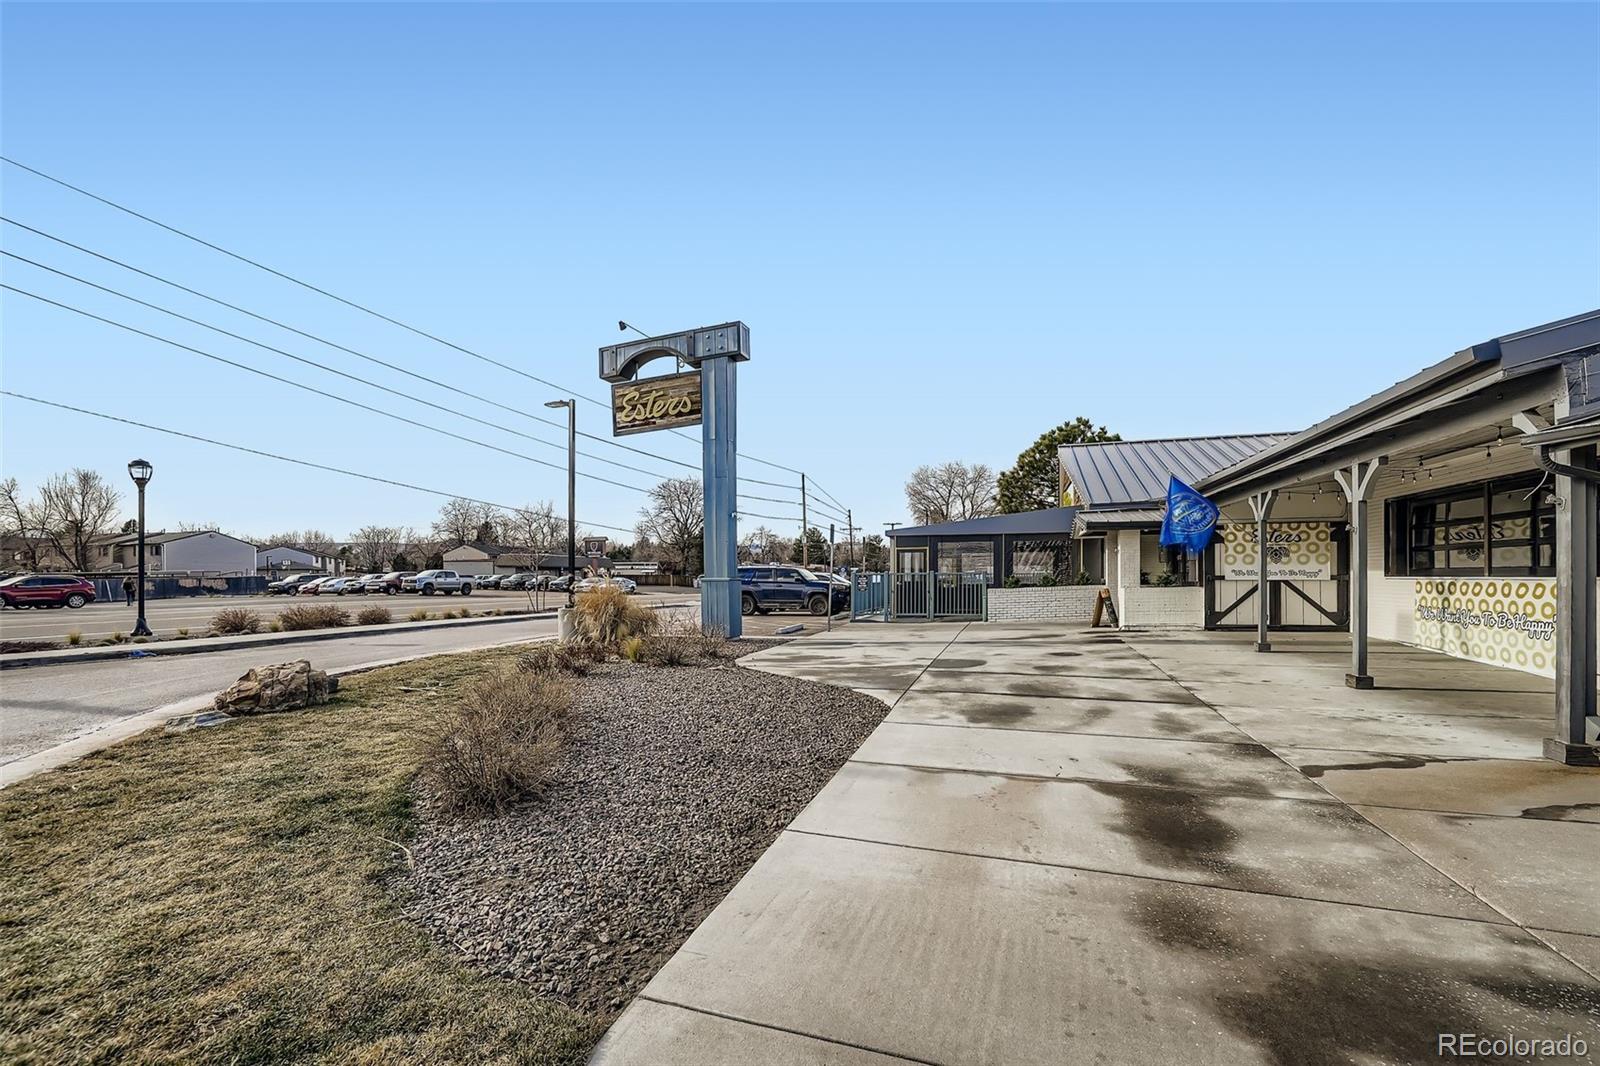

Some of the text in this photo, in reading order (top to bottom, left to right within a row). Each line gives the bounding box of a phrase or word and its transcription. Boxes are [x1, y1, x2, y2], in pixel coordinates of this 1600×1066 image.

[621, 390, 692, 422] Esters
[1250, 529, 1302, 544] Eters
[1460, 608, 1481, 630] You
[1480, 610, 1497, 628] To
[1497, 611, 1515, 630] Be
